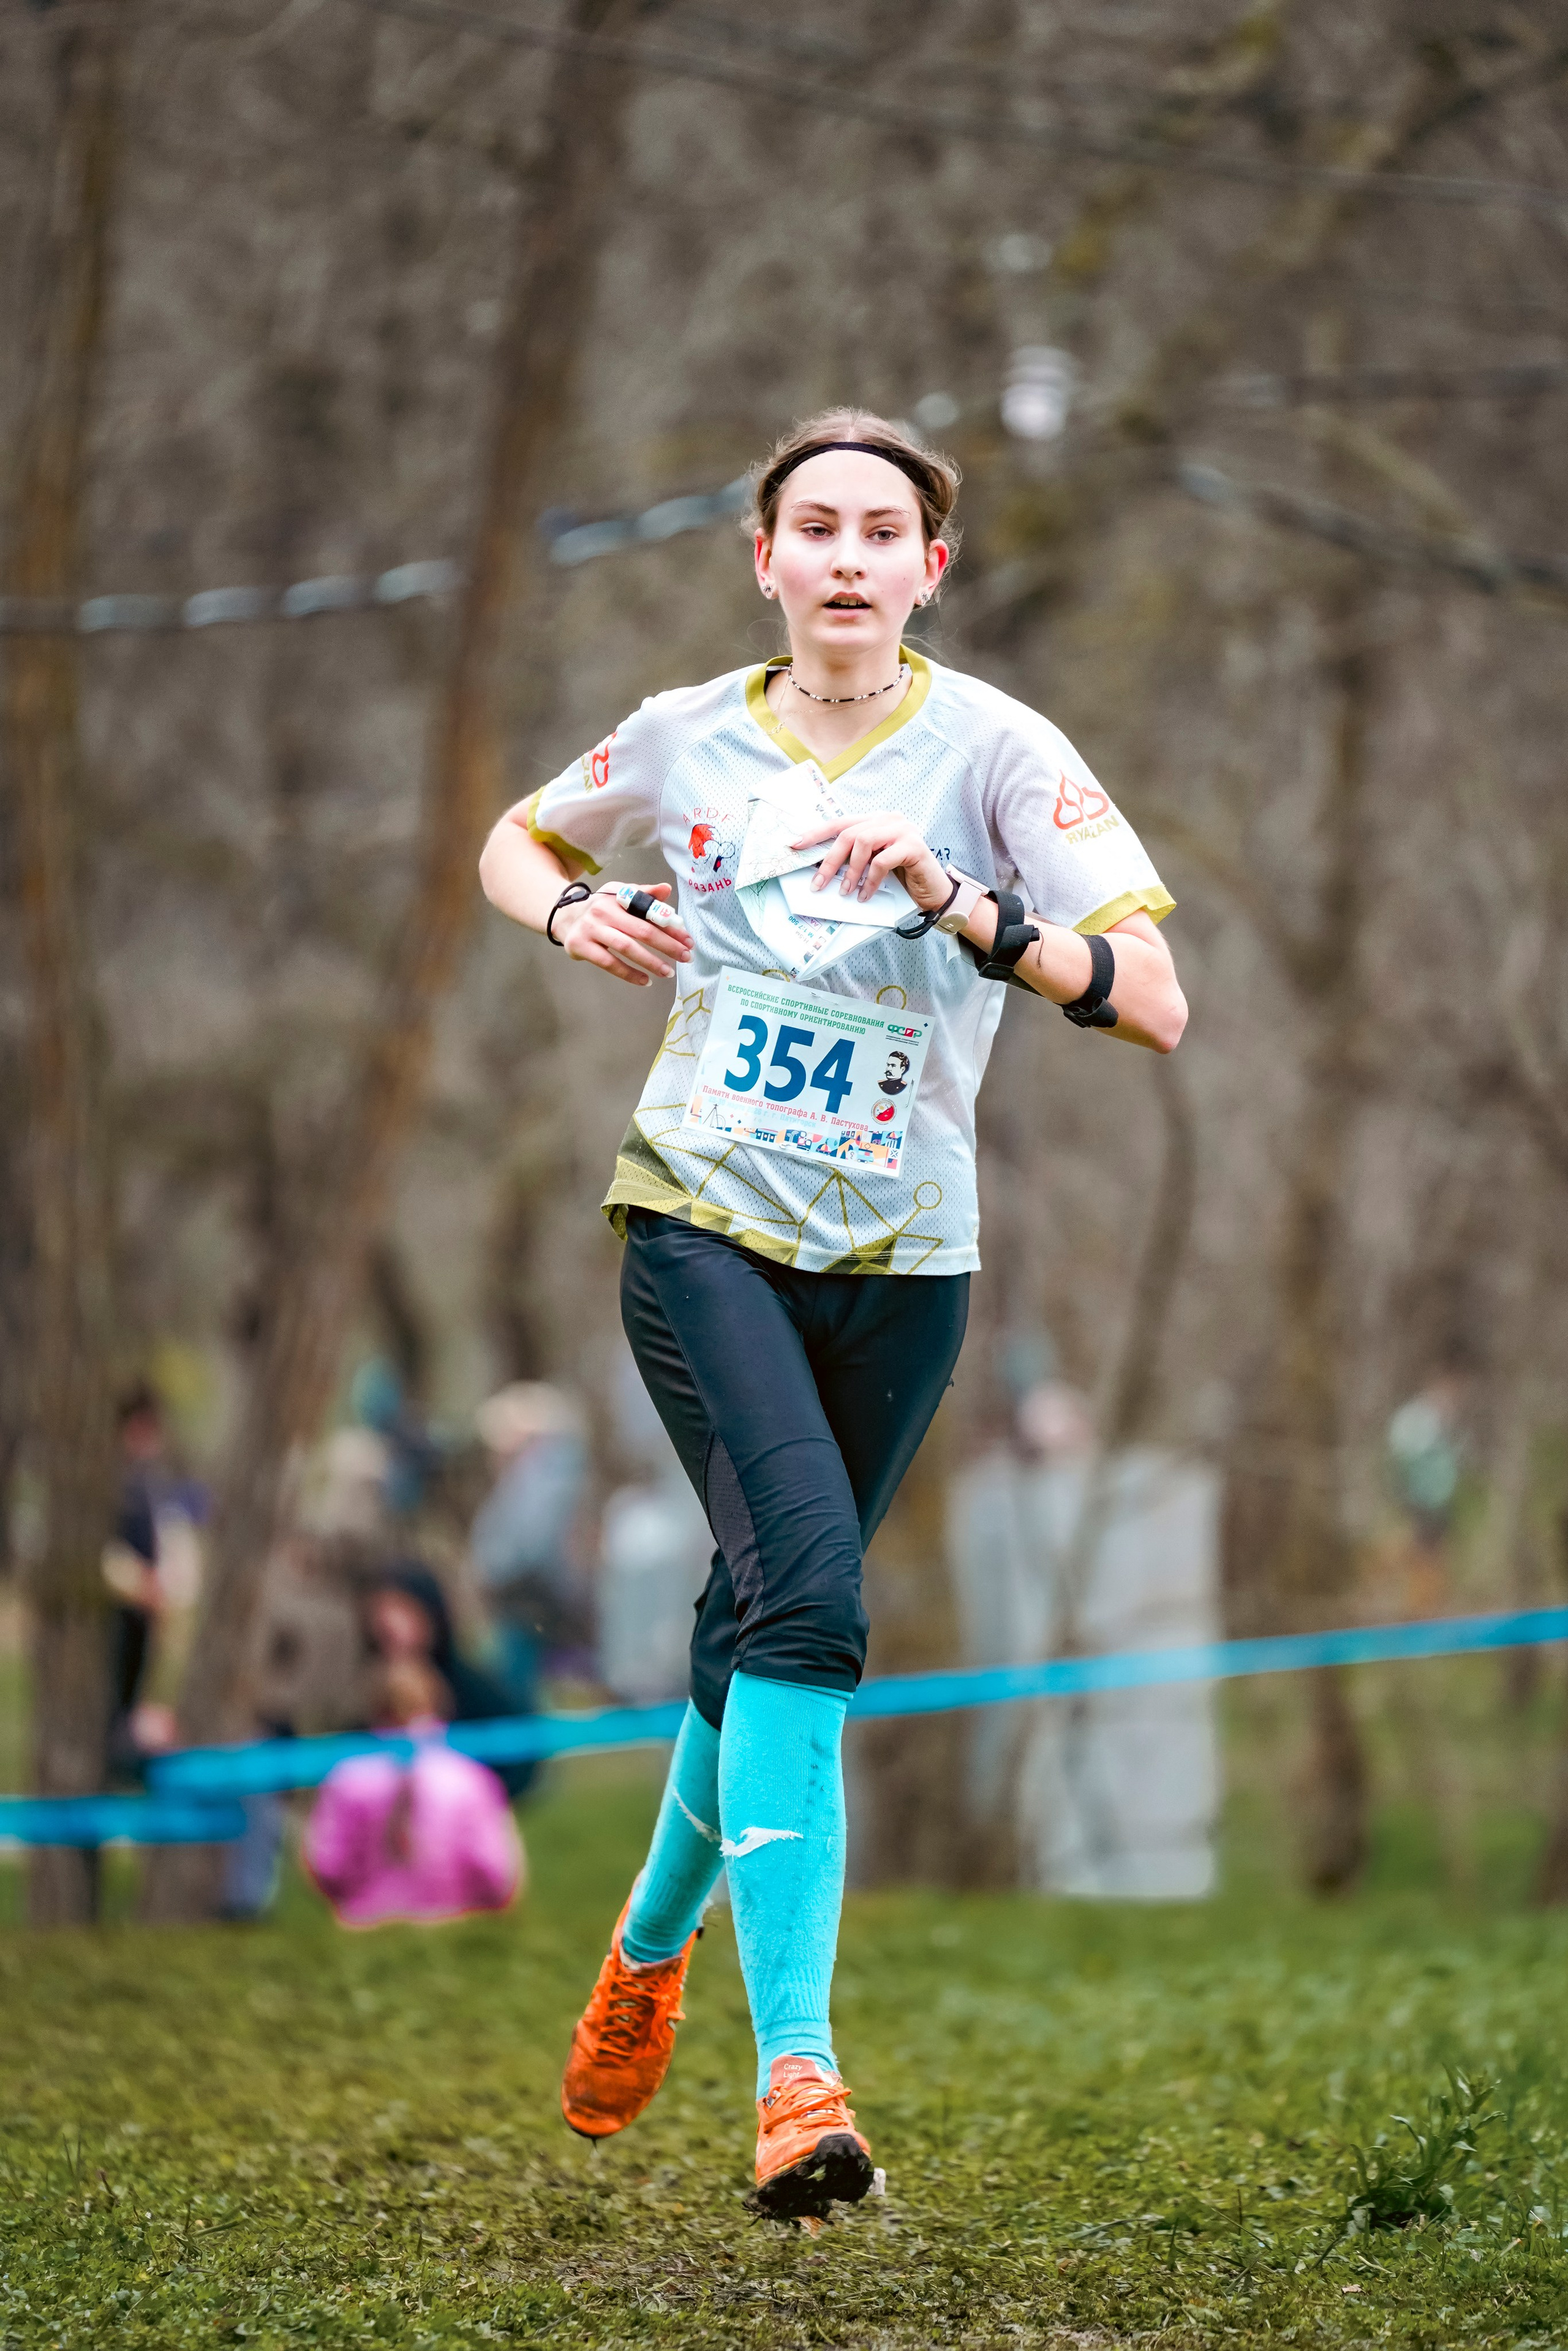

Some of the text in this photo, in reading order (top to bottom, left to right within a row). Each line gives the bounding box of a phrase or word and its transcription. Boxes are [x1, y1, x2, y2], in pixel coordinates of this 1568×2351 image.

[683, 807, 735, 826] ARDF
[688, 877, 732, 892] РЯЗАНЬ
[788, 916, 799, 926] 500
[728, 984, 885, 1028] ВСЕРОССИЙСКИЕ СПОРТИВНЫЕ СОРЕВНОВАНИЯ
[750, 1001, 798, 1018] СПОРТИВНОМУ
[800, 1013, 866, 1035] ОРИЕНТИРОВАНИЮ
[724, 1014, 856, 1114] 354
[703, 1085, 730, 1098] Памяти
[732, 1094, 763, 1108] военного
[766, 1103, 807, 1118] топографа
[820, 1114, 827, 1123] В.
[831, 1117, 869, 1131] Пастухова
[780, 1114, 816, 1128] Пятигорск
